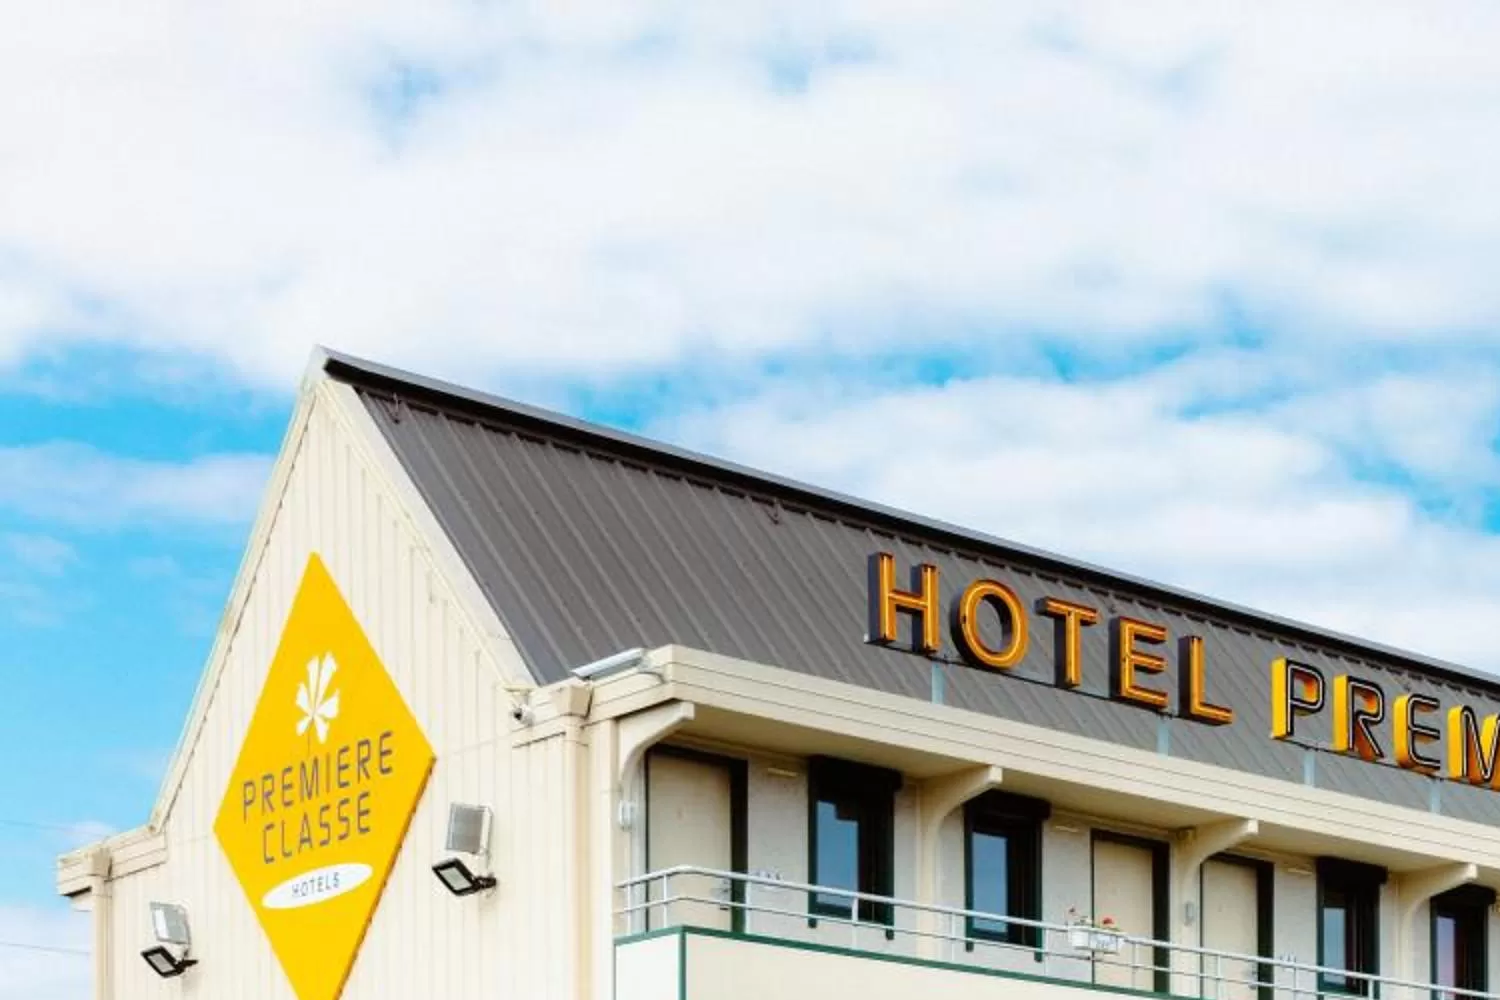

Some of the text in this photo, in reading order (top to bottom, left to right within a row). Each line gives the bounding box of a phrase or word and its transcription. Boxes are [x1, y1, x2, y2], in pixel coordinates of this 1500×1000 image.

[867, 551, 1233, 725] HOTEL
[243, 730, 394, 824] PREMIERE
[263, 791, 371, 864] CLASSE
[291, 872, 341, 898] HOTELS
